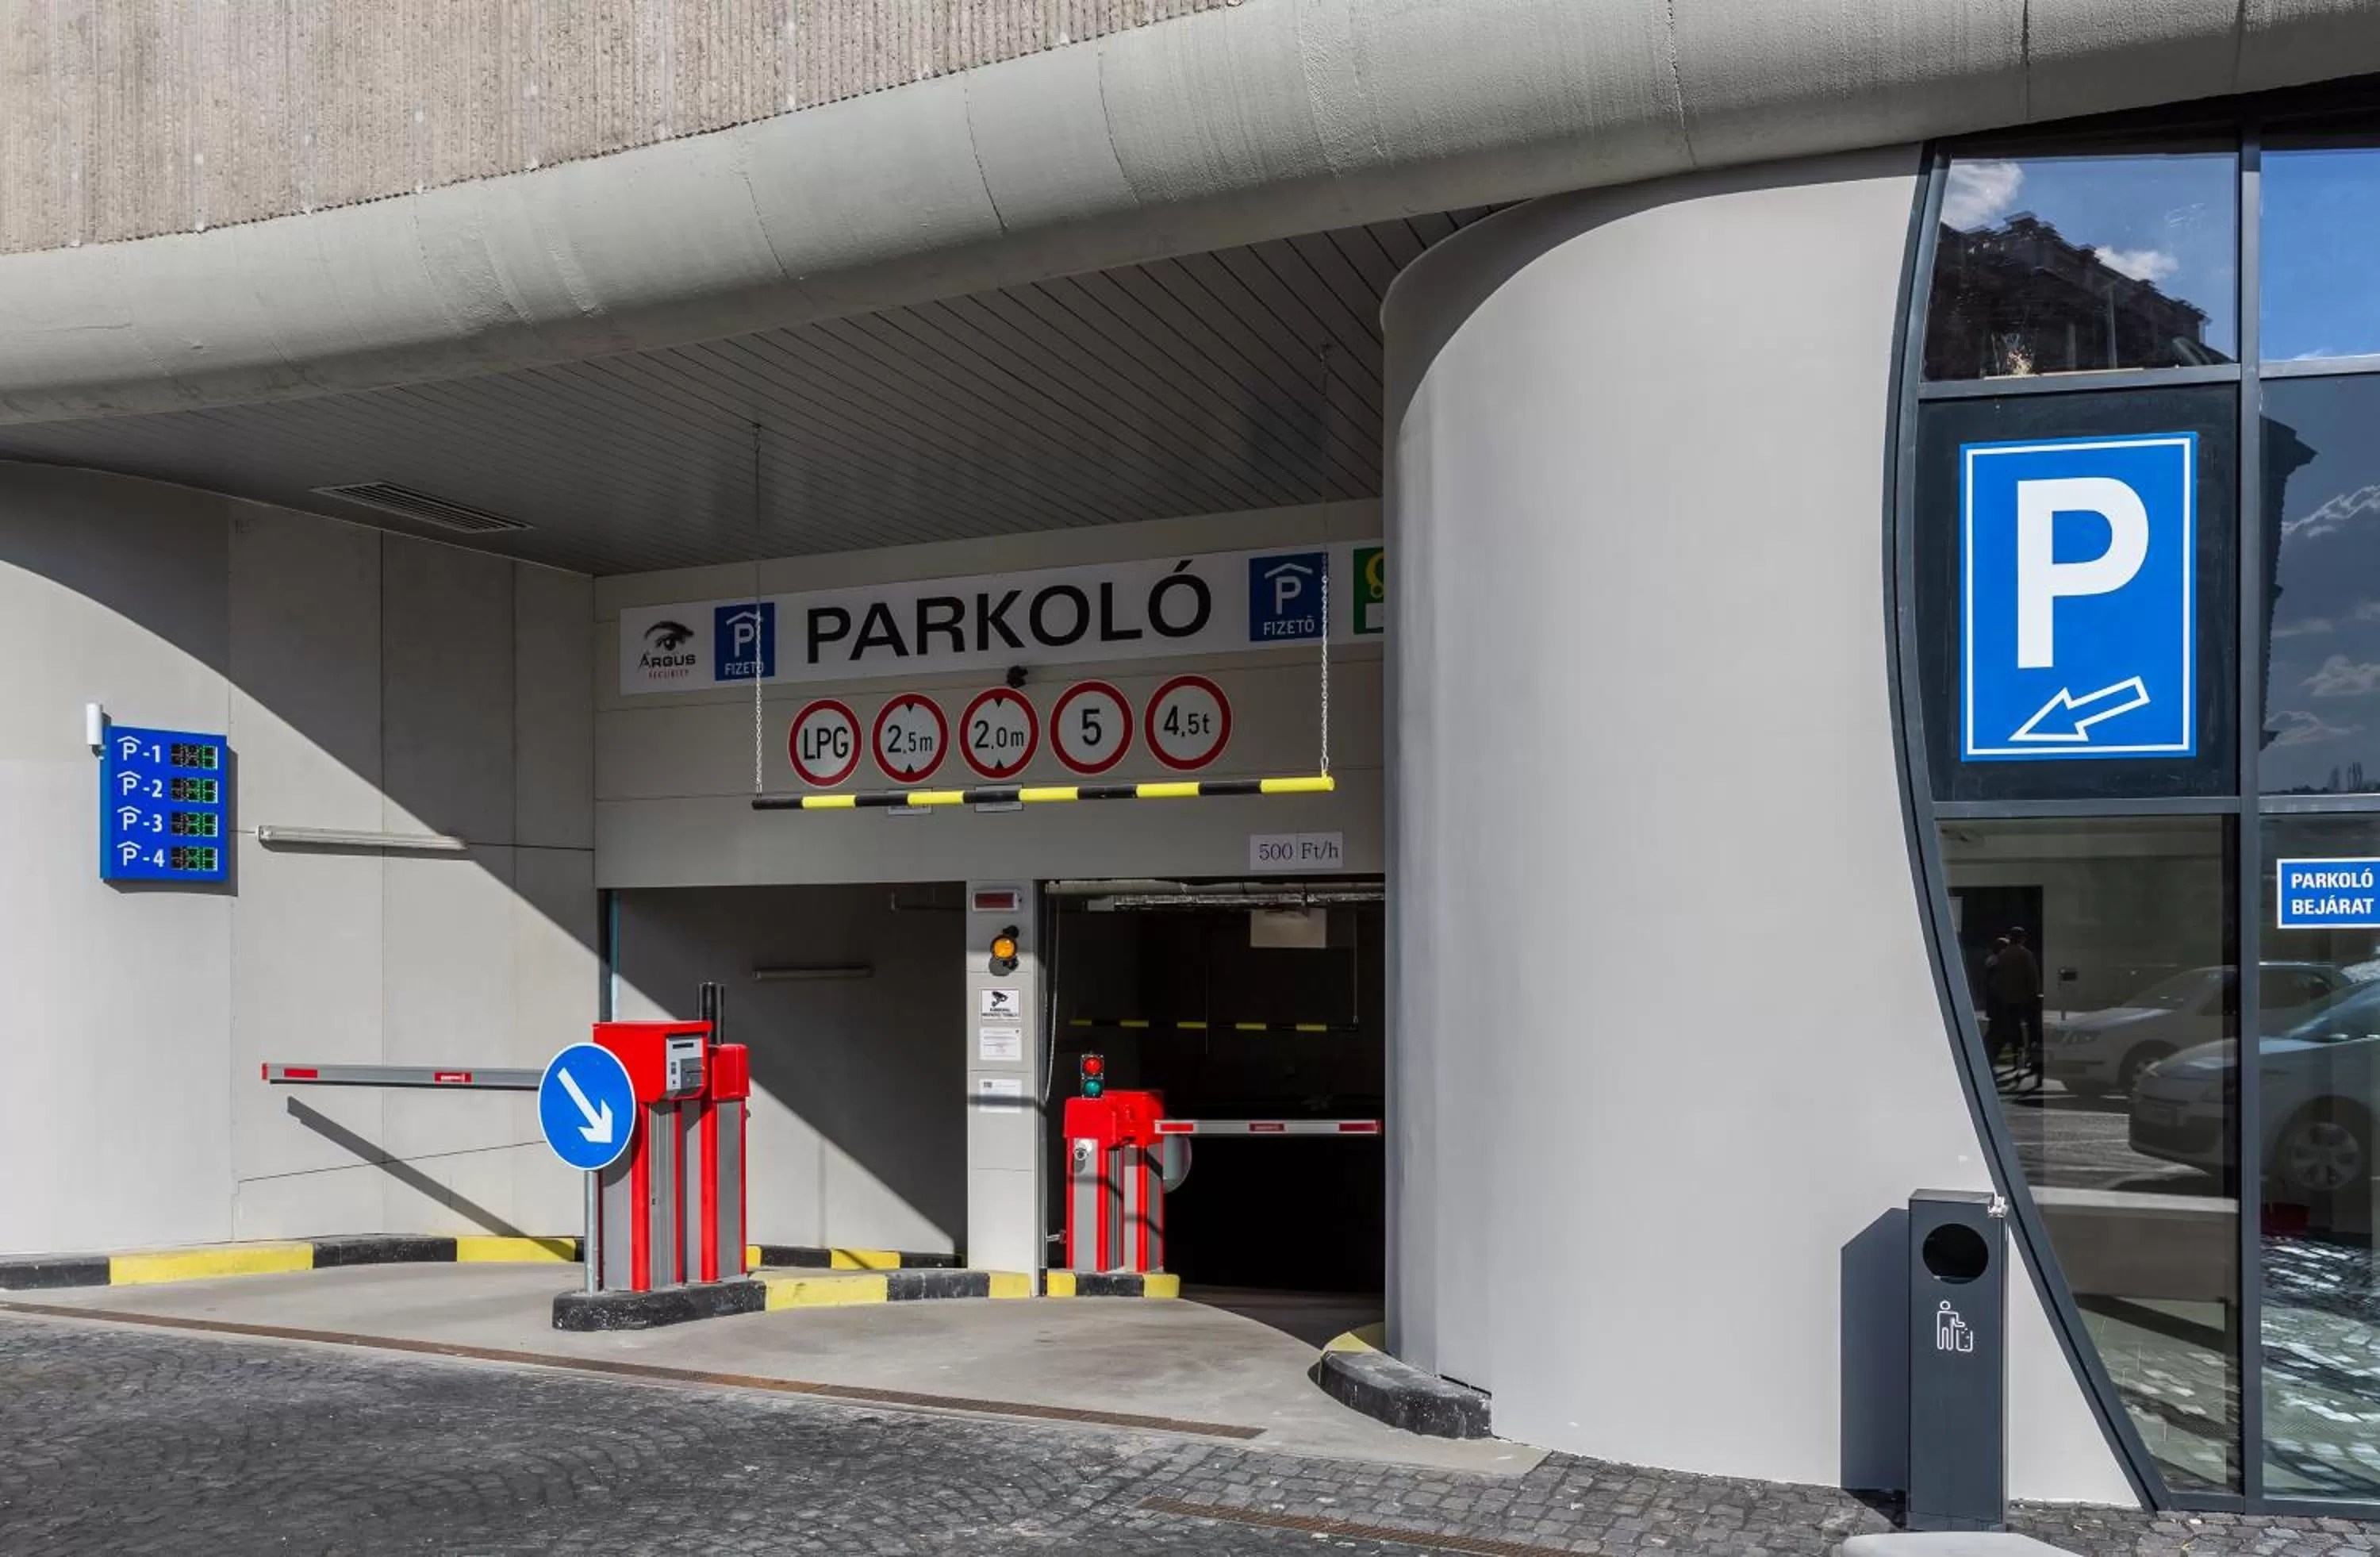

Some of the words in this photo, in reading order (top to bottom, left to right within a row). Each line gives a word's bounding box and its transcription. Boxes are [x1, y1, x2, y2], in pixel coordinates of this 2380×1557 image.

[2017, 477, 2149, 669] P
[807, 559, 1211, 663] PARKOLÓ
[1276, 575, 1301, 614] P
[734, 623, 754, 657] P
[804, 726, 849, 759] LPG
[1081, 708, 1102, 745] 5
[1259, 843, 1293, 860] 500
[1301, 841, 1339, 860] Ft/h
[2291, 868, 2374, 889] PARKOLÓ
[2291, 895, 2374, 914] BEJÁRAT
